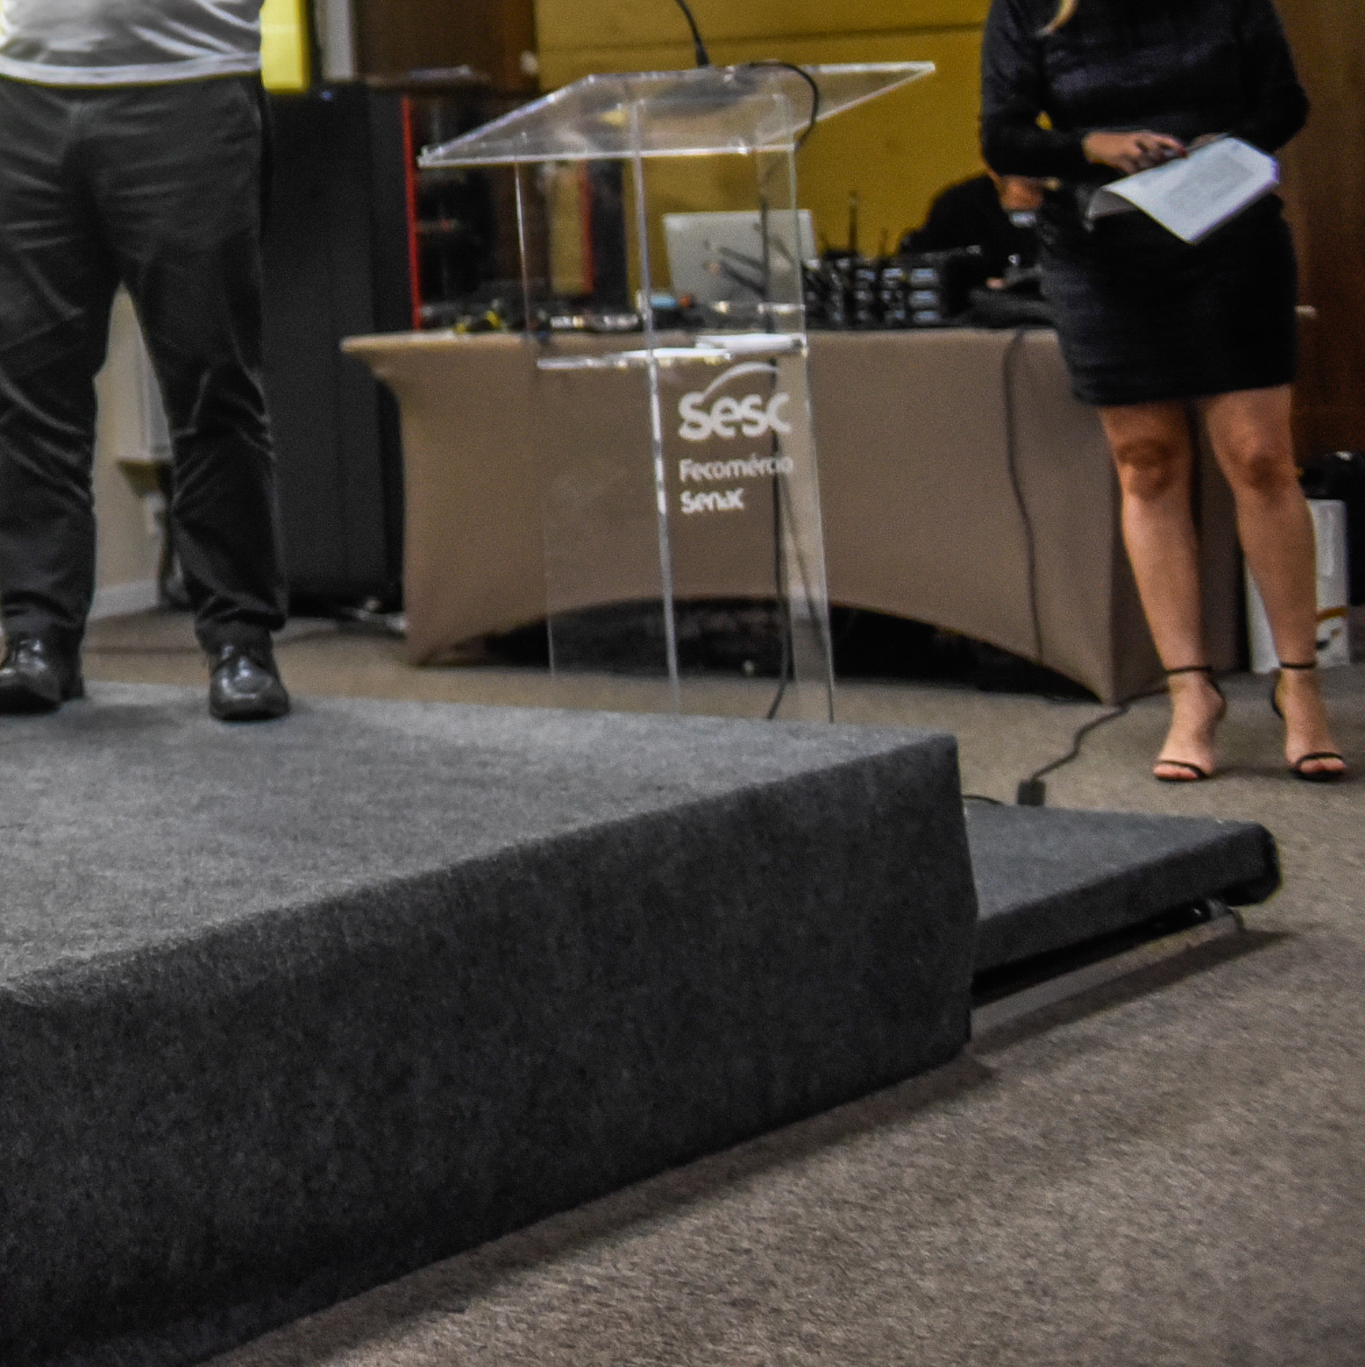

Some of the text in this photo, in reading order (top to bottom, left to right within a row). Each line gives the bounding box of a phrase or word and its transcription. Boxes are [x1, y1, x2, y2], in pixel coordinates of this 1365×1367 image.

[678, 391, 791, 440] Sesc
[679, 453, 794, 482] Fecomércio
[680, 488, 745, 514] Senac
